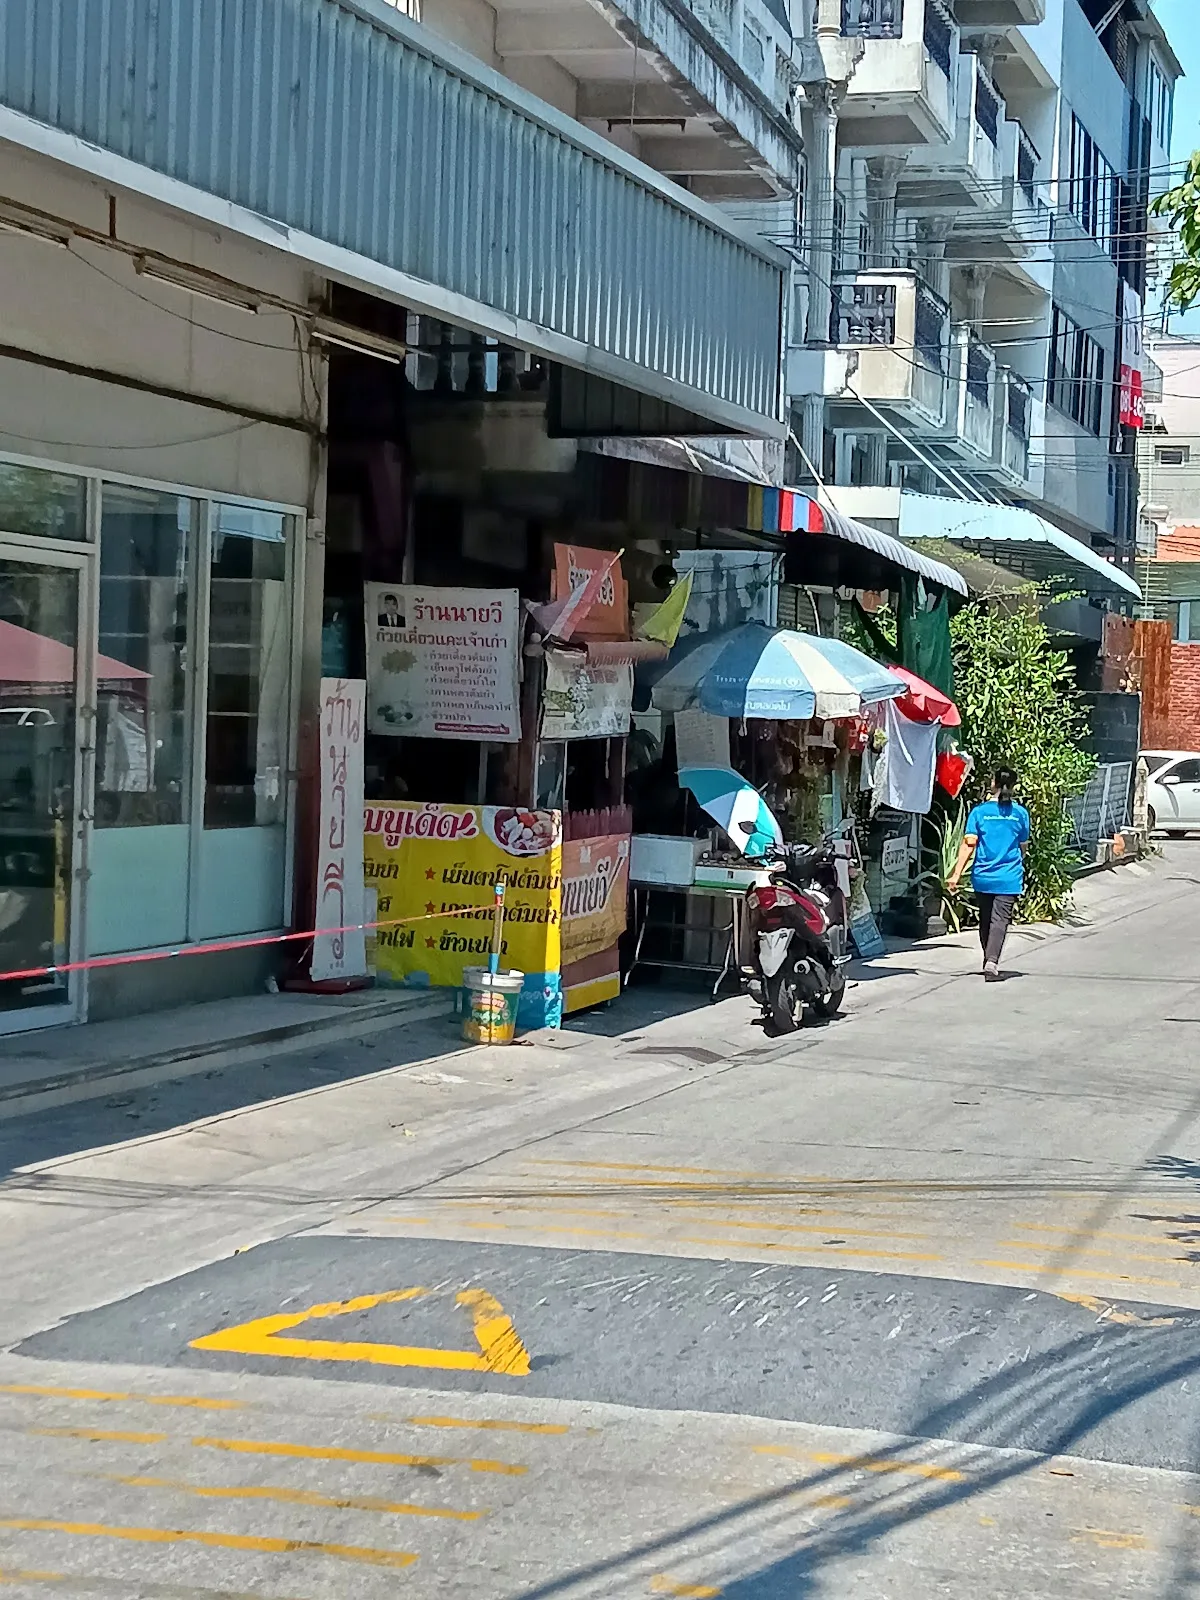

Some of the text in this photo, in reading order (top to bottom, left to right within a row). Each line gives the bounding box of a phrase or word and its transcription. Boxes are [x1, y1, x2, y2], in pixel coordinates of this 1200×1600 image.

[413, 597, 503, 624] ร้านนายวี
[364, 802, 477, 847] มนูเด็ด
[363, 857, 400, 880] ต้มยำ
